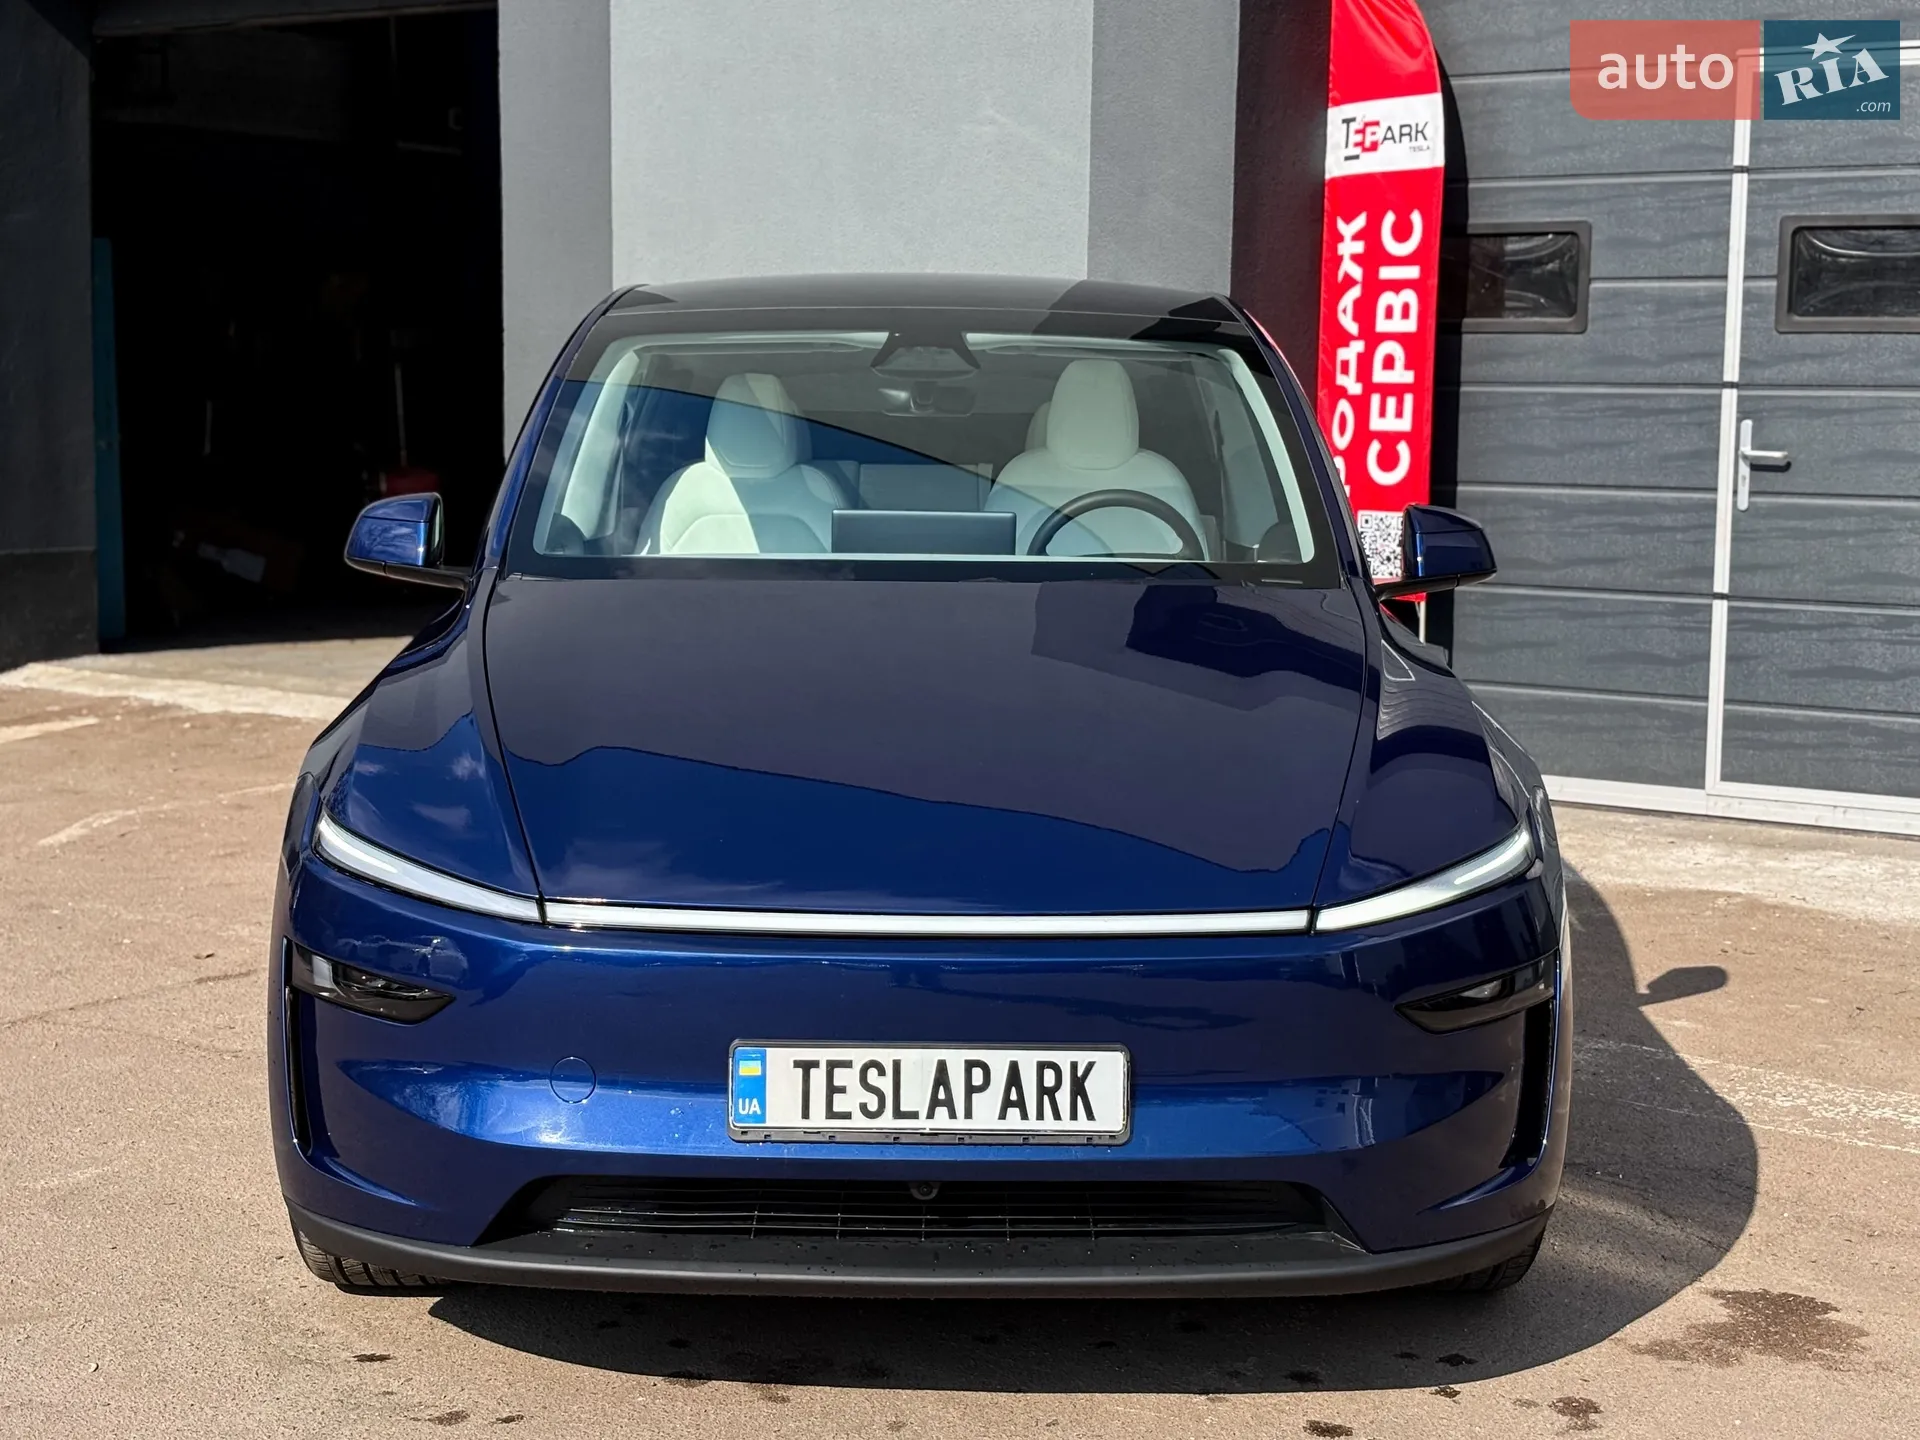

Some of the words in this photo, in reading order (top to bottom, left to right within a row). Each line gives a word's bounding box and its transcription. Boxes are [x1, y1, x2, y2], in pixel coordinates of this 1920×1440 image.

[1366, 209, 1422, 486] СЕРВІС
[738, 1098, 761, 1115] UA
[793, 1059, 1096, 1121] TESLAPARK
